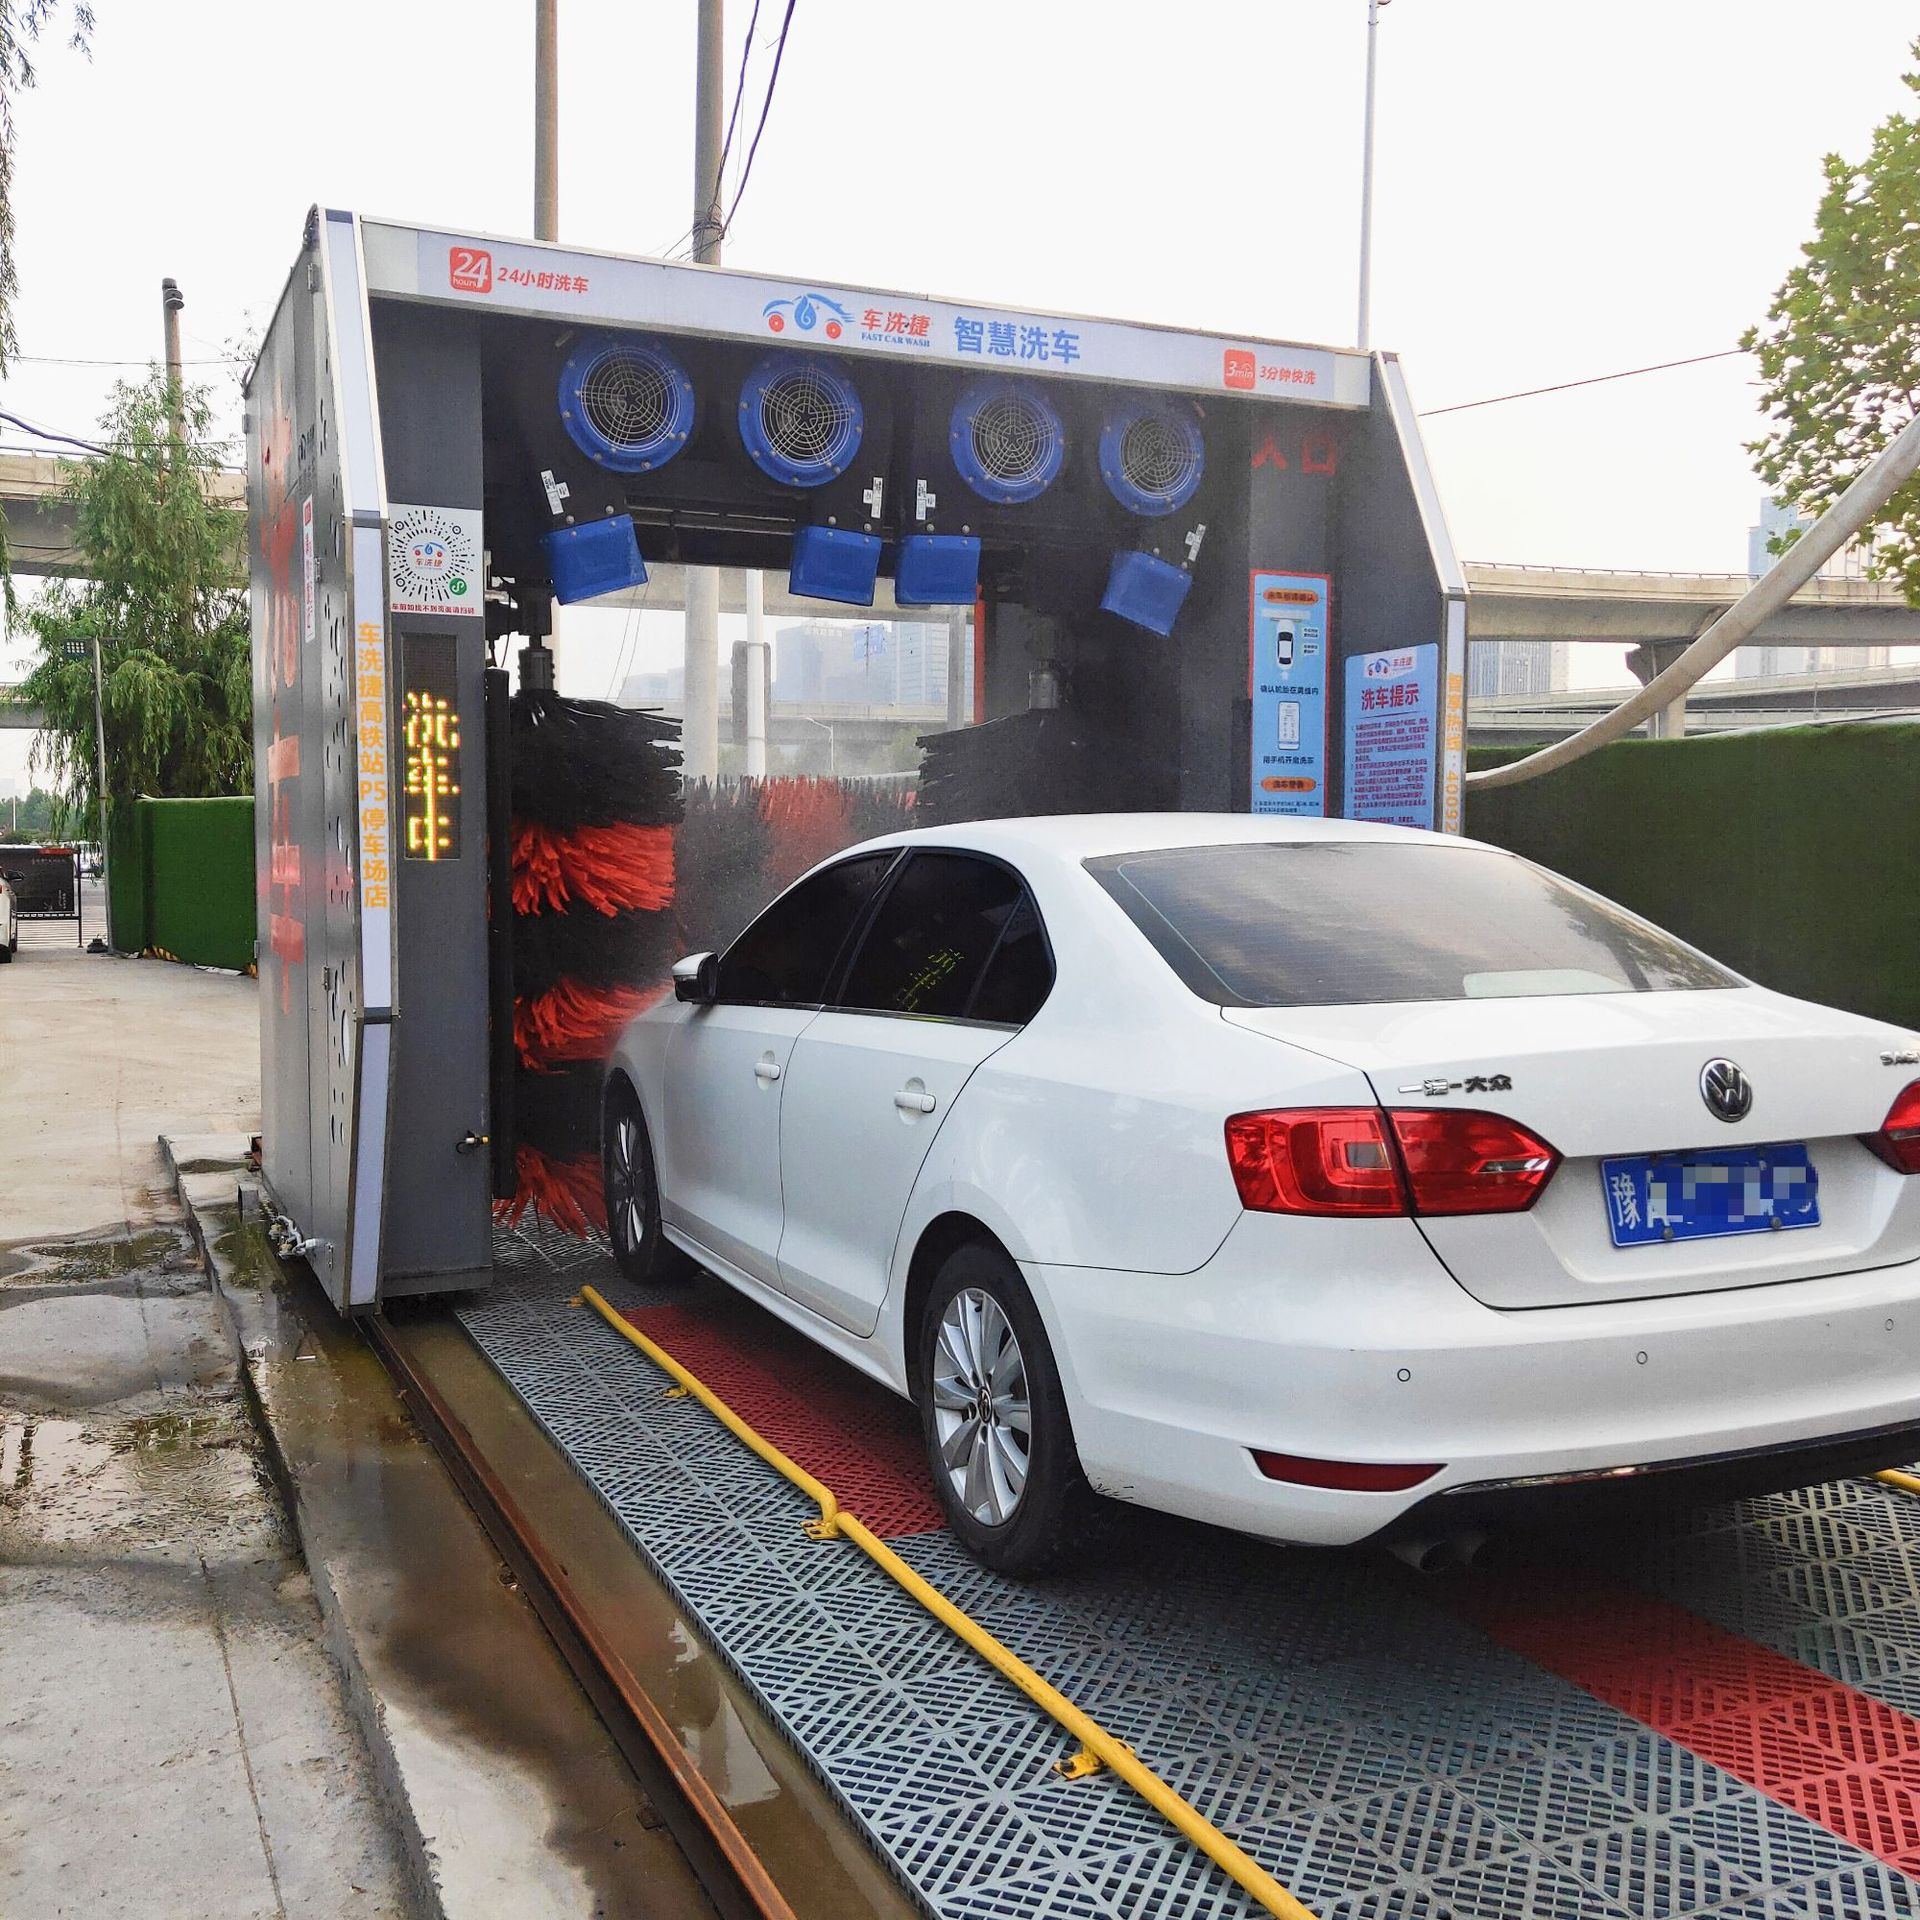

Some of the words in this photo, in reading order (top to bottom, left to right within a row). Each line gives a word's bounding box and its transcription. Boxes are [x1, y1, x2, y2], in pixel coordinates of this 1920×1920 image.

[452, 276, 479, 288] hours
[453, 252, 489, 289] 24
[497, 266, 590, 293] 24小时洗车
[861, 308, 931, 337] 车洗捷
[861, 331, 884, 342] FAST
[884, 335, 904, 345] CAR
[905, 337, 931, 348] WASH
[954, 315, 1081, 365] 智慧洗车
[1259, 365, 1317, 385] 3分钟快洗
[1361, 682, 1420, 711] 洗车提示
